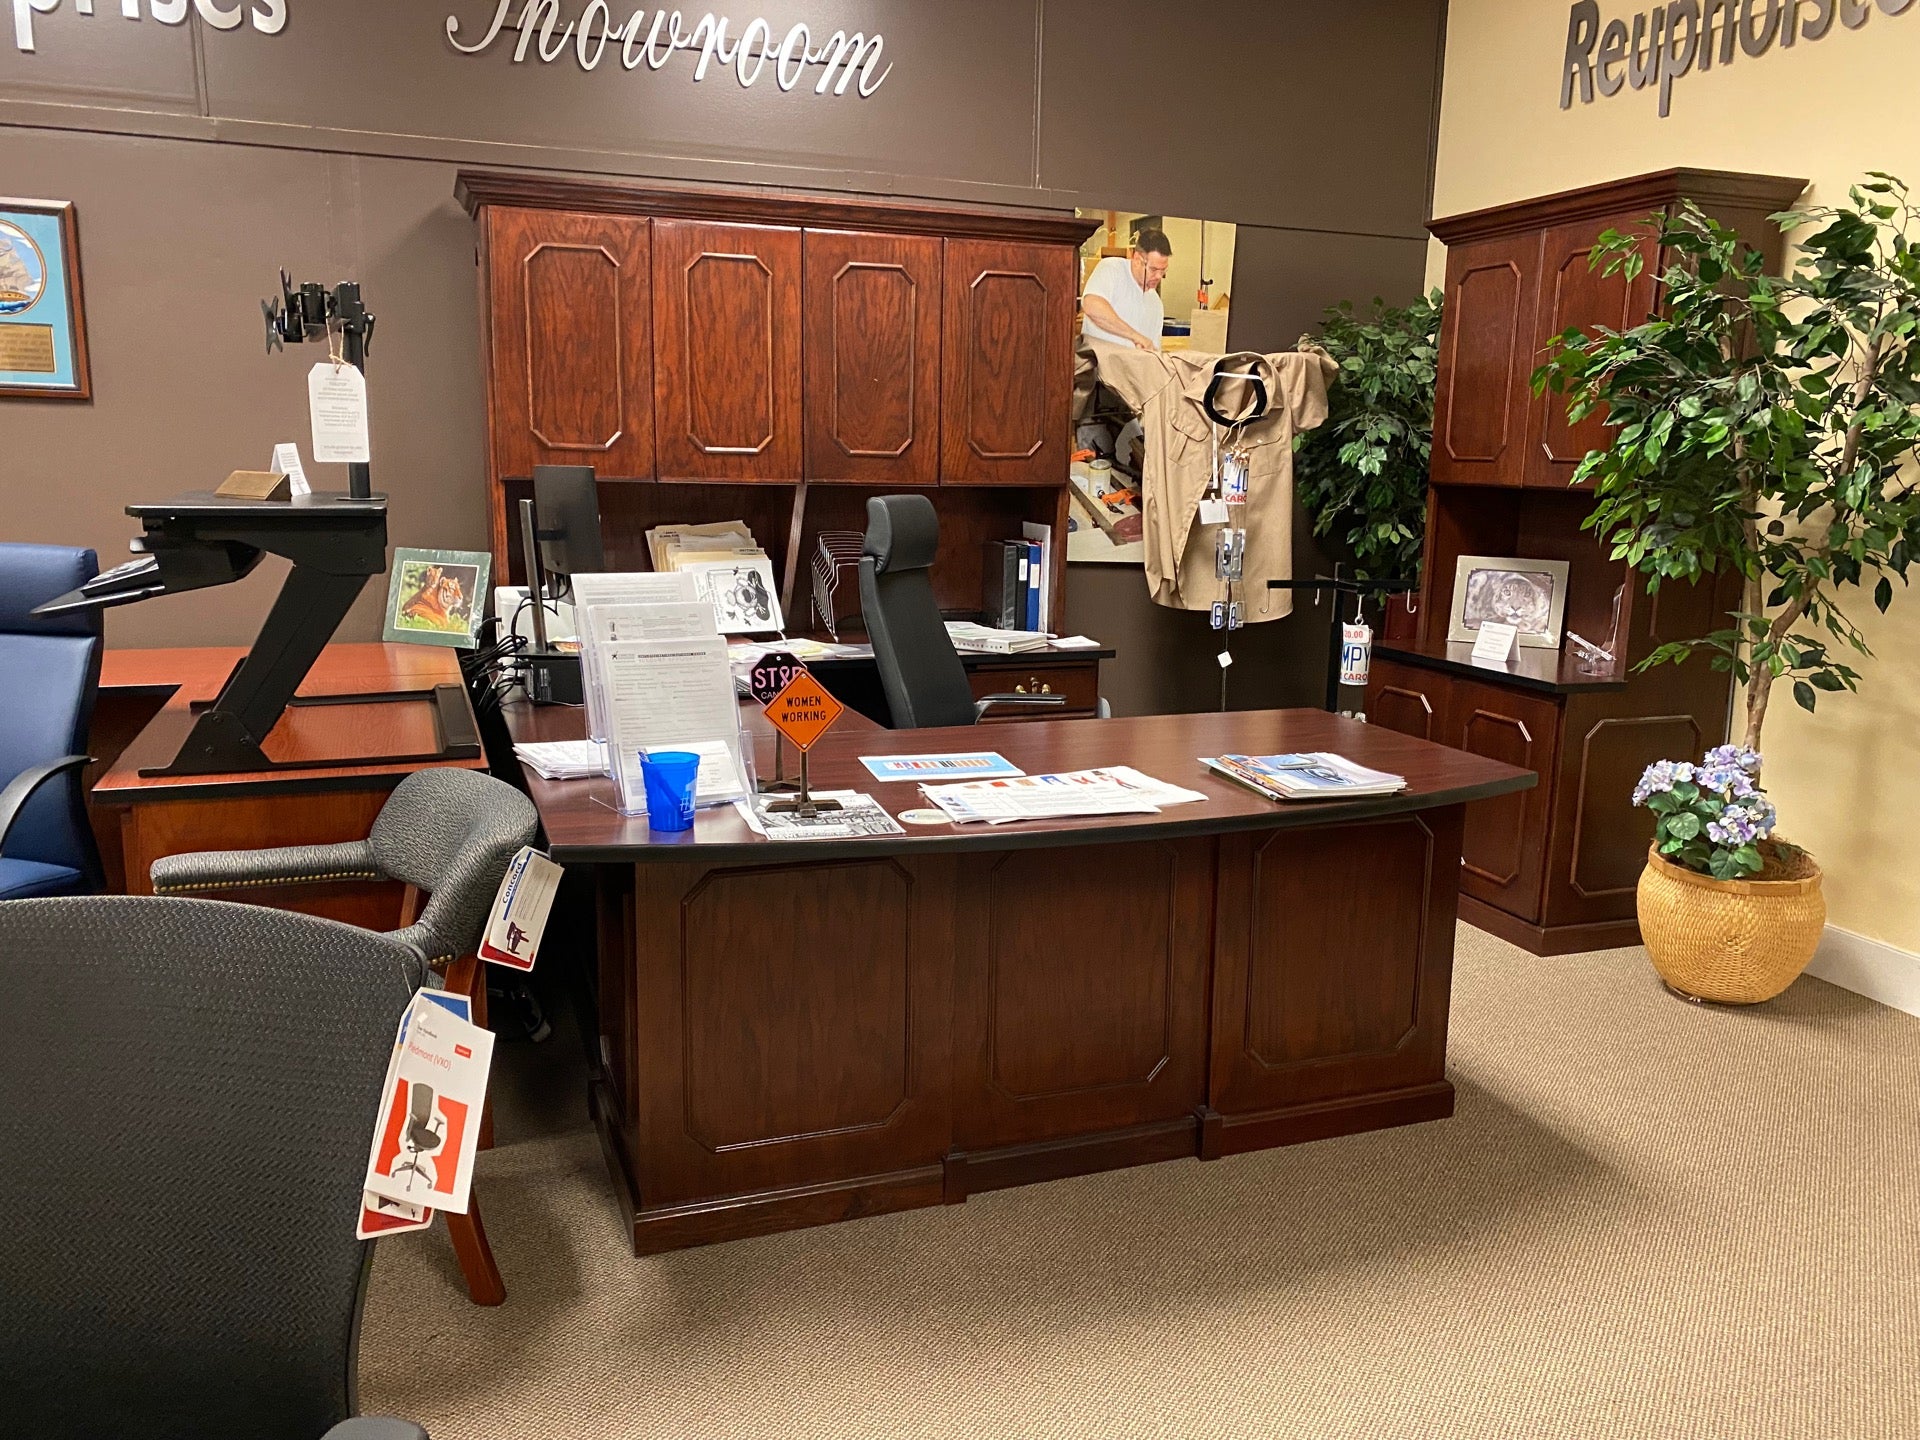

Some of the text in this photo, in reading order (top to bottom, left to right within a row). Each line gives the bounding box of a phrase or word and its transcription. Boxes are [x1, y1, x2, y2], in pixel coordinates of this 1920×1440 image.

[760, 690, 779, 700] CAN
[786, 695, 822, 707] WOMEN
[781, 710, 827, 723] WORKING
[503, 862, 522, 904] Concord
